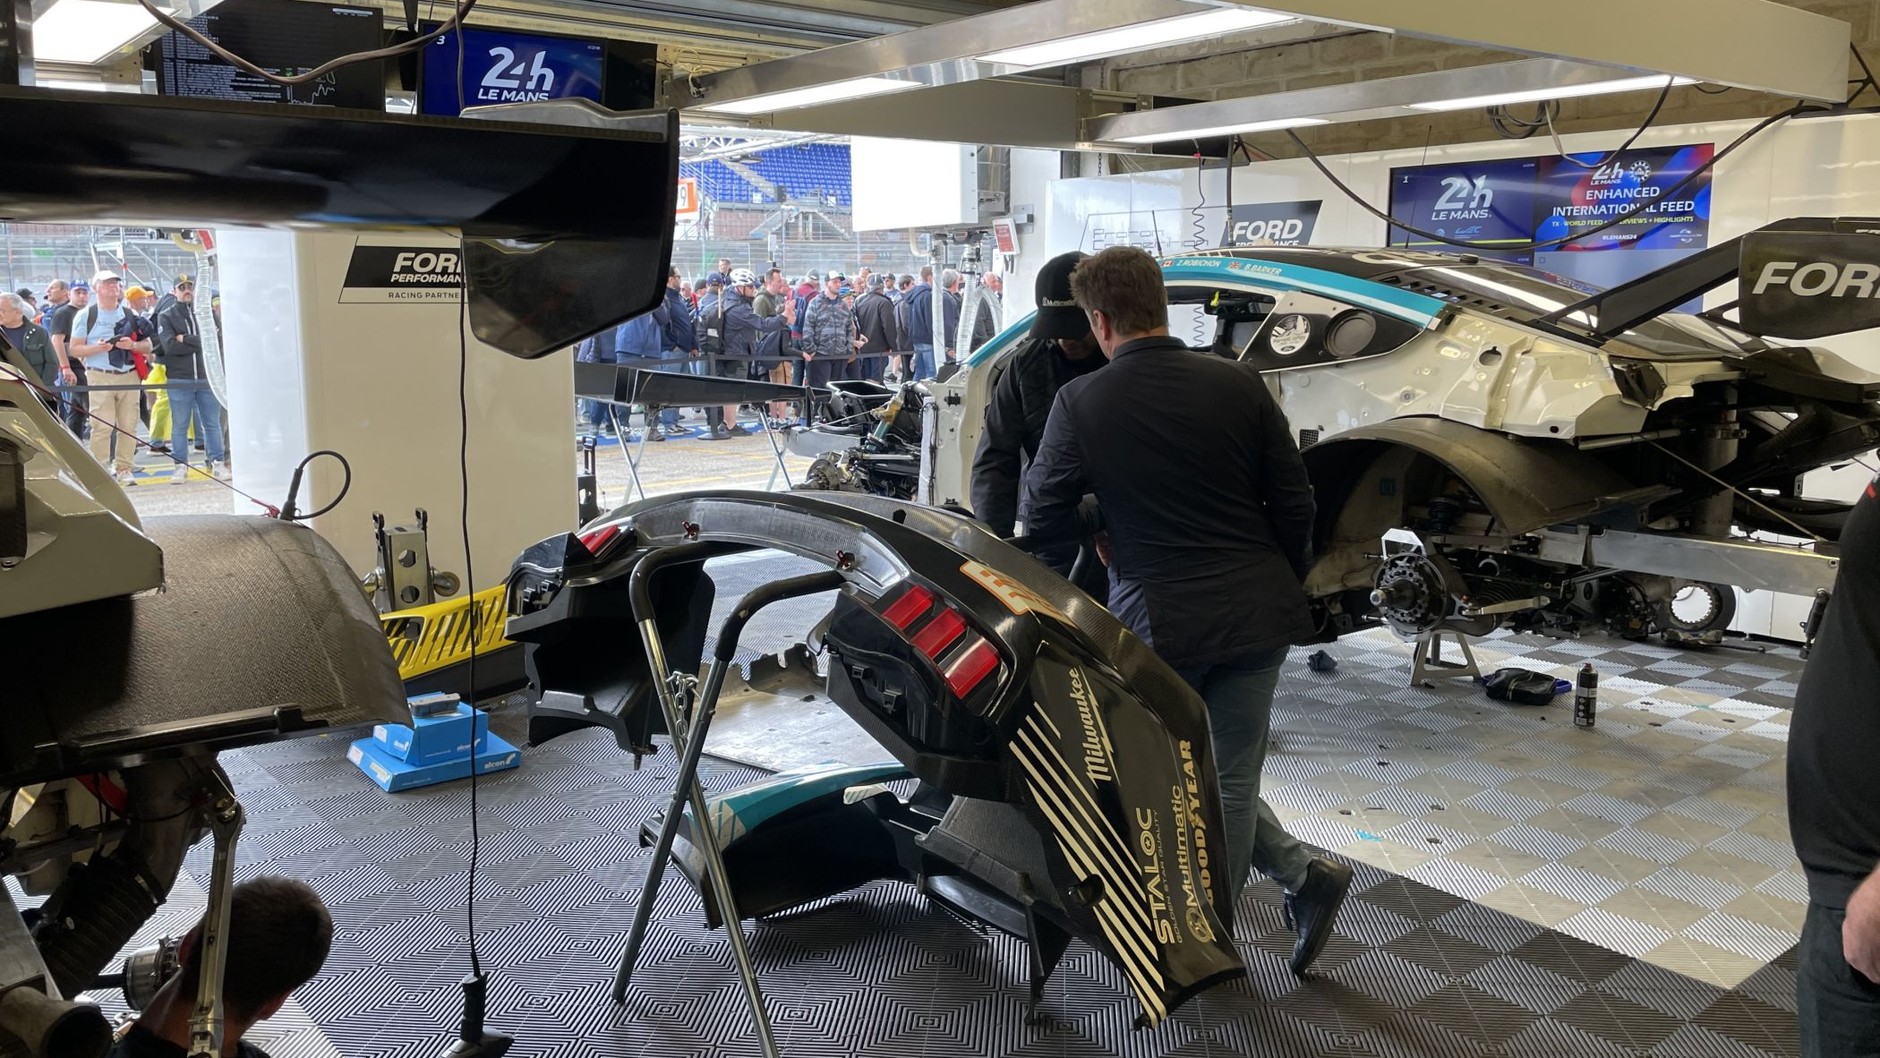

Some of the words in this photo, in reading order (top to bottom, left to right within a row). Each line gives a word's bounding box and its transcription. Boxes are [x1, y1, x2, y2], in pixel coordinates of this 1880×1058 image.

[436, 35, 445, 45] 3
[481, 46, 555, 90] 24h
[478, 88, 499, 100] LE
[501, 90, 549, 102] MANS
[1402, 175, 1409, 184] 1
[1434, 174, 1493, 210] 24h
[1585, 186, 1660, 200] ENHANCED
[1431, 210, 1448, 221] LE
[1449, 209, 1489, 220] MANS
[1552, 203, 1658, 217] INTERNATIONL
[1660, 200, 1695, 212] FEED
[1233, 219, 1303, 241] FORD
[1752, 261, 1880, 299] FOR
[1068, 667, 1112, 790] Milwaukee
[484, 760, 505, 769] alcon
[1171, 785, 1198, 907] Multimatic
[1136, 807, 1175, 944] STALOC
